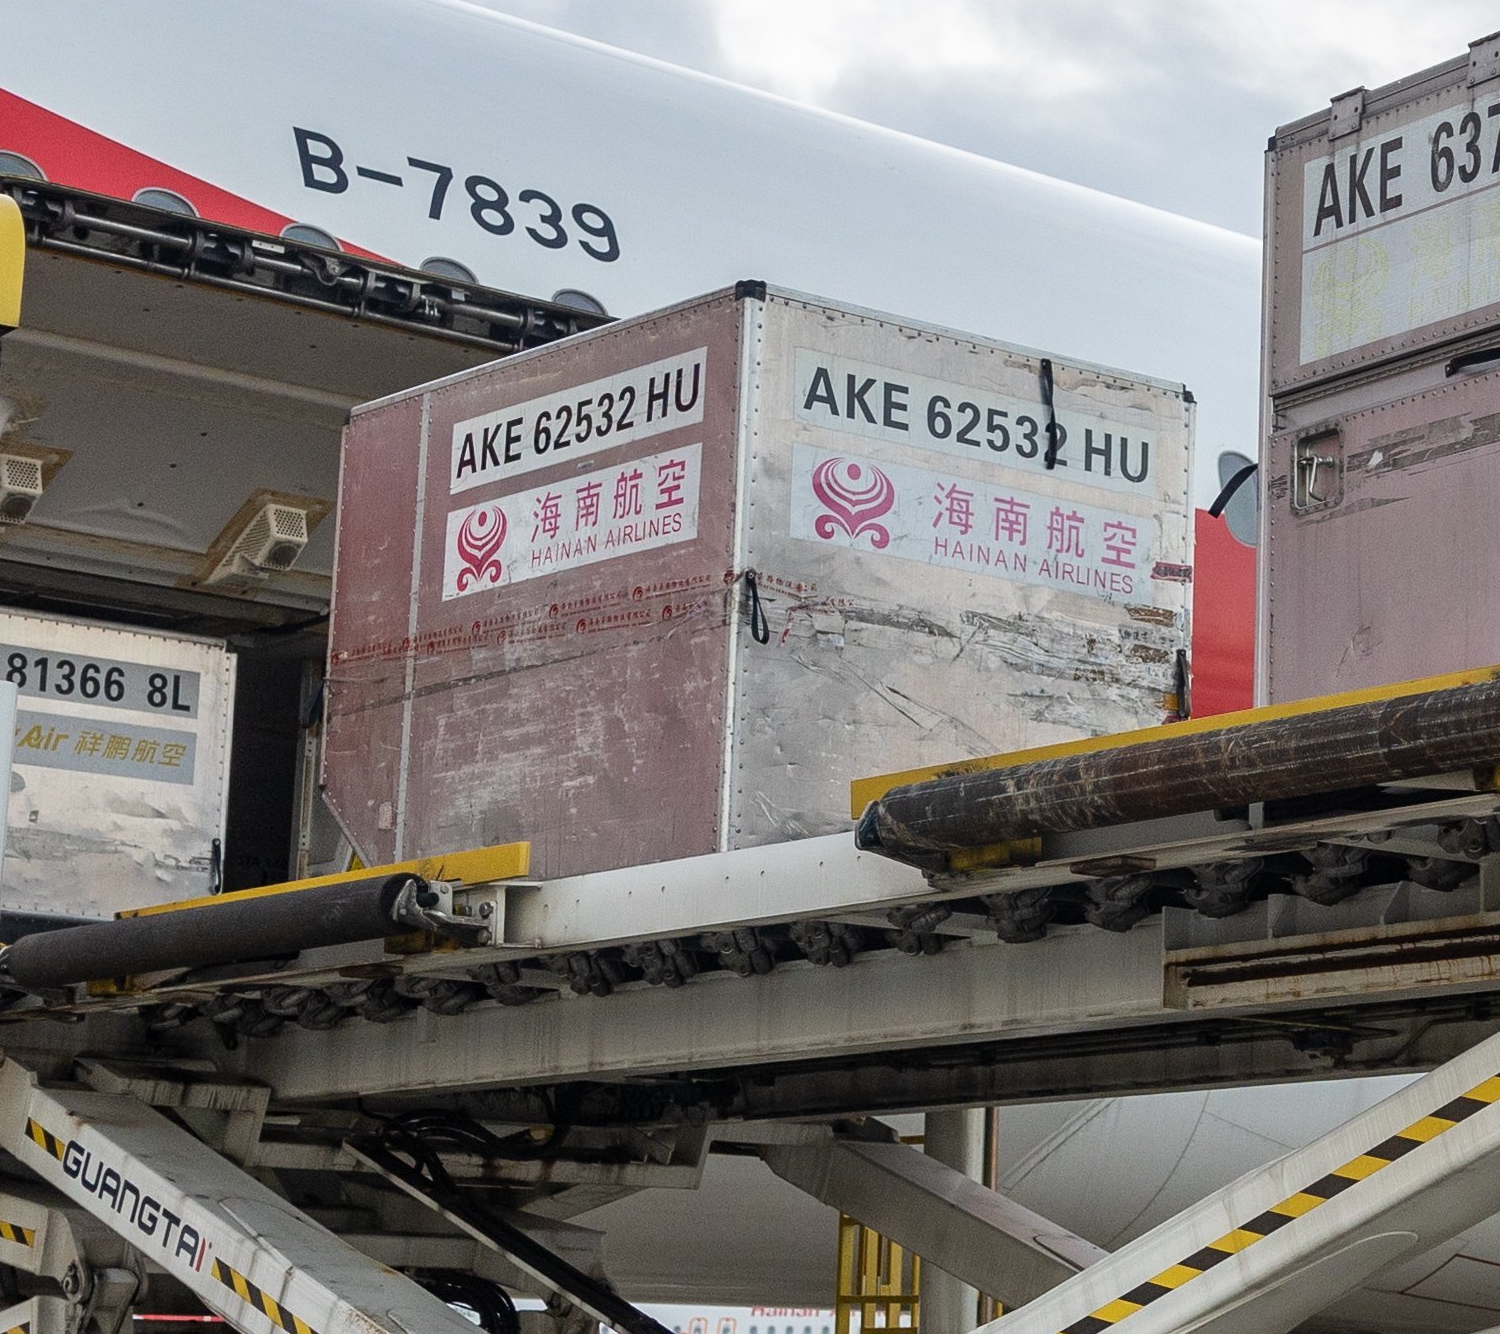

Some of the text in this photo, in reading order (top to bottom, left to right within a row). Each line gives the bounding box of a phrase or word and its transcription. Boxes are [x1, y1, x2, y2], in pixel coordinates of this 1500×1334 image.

[294, 127, 620, 263] B-7839
[1314, 135, 1403, 237] AKE
[455, 363, 700, 478] AKE 62532 HU
[802, 366, 1150, 484] AKE 62532 HU
[531, 512, 683, 569] HAINAN AIRLINES
[532, 456, 687, 543] 海南航空
[932, 480, 1137, 571] 海南航空
[933, 535, 1031, 572] HAINAN
[1038, 557, 1134, 593] AIRLINES
[6, 653, 190, 712] 81366 8L
[15, 725, 188, 767] Air 祥鹏航空
[63, 1140, 206, 1273] GUANGTAI
